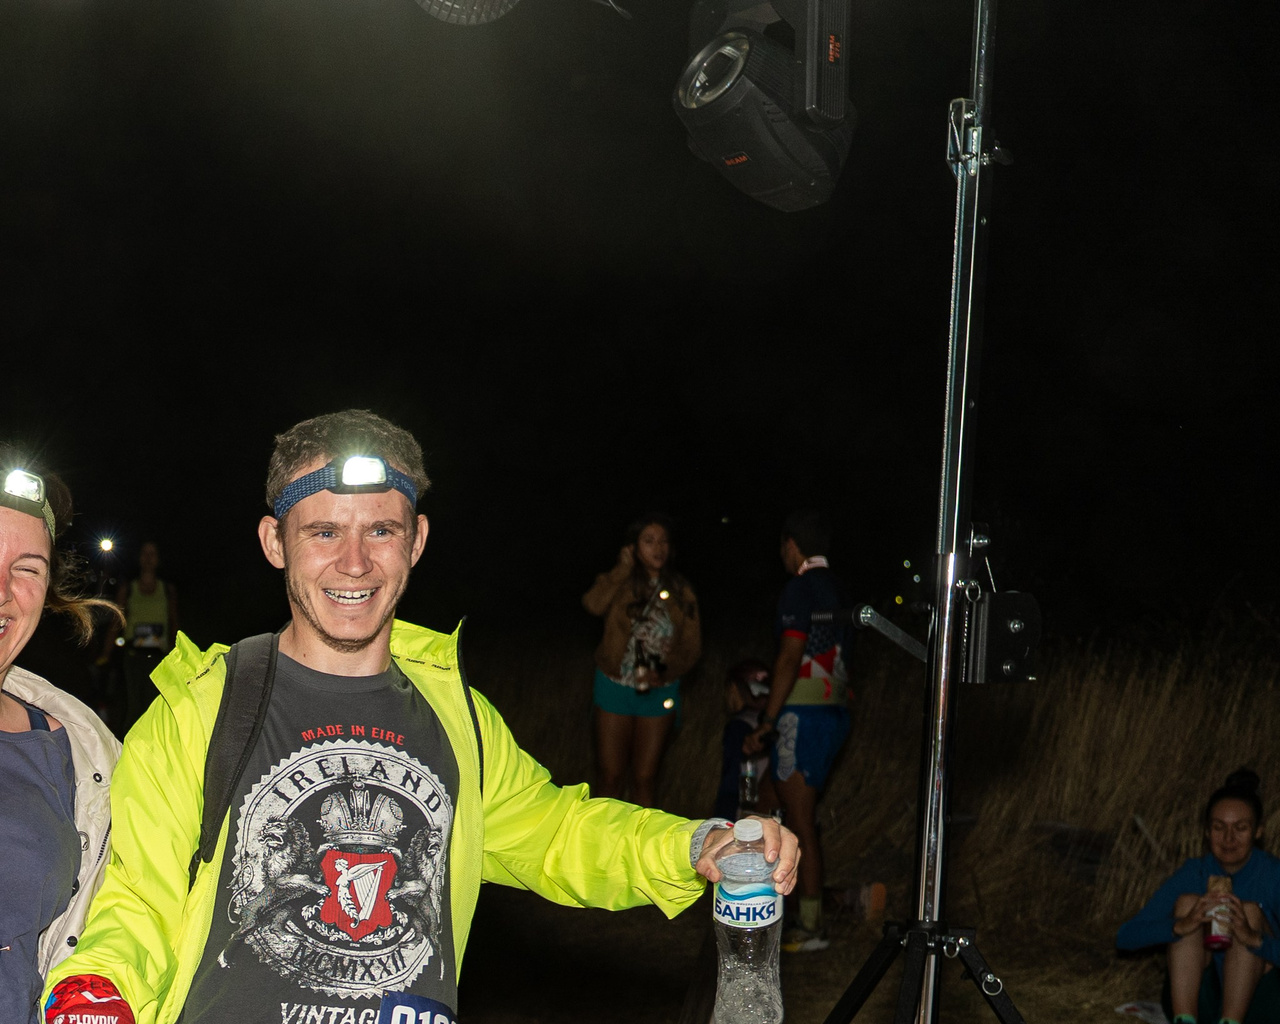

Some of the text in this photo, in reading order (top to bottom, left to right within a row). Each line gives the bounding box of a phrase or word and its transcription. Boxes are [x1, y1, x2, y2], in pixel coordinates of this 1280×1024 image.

[724, 155, 748, 166] BEAM
[301, 725, 406, 746] MADE IN EIRE
[272, 756, 442, 813] IRELAND
[715, 898, 776, 921] БАНКЯ
